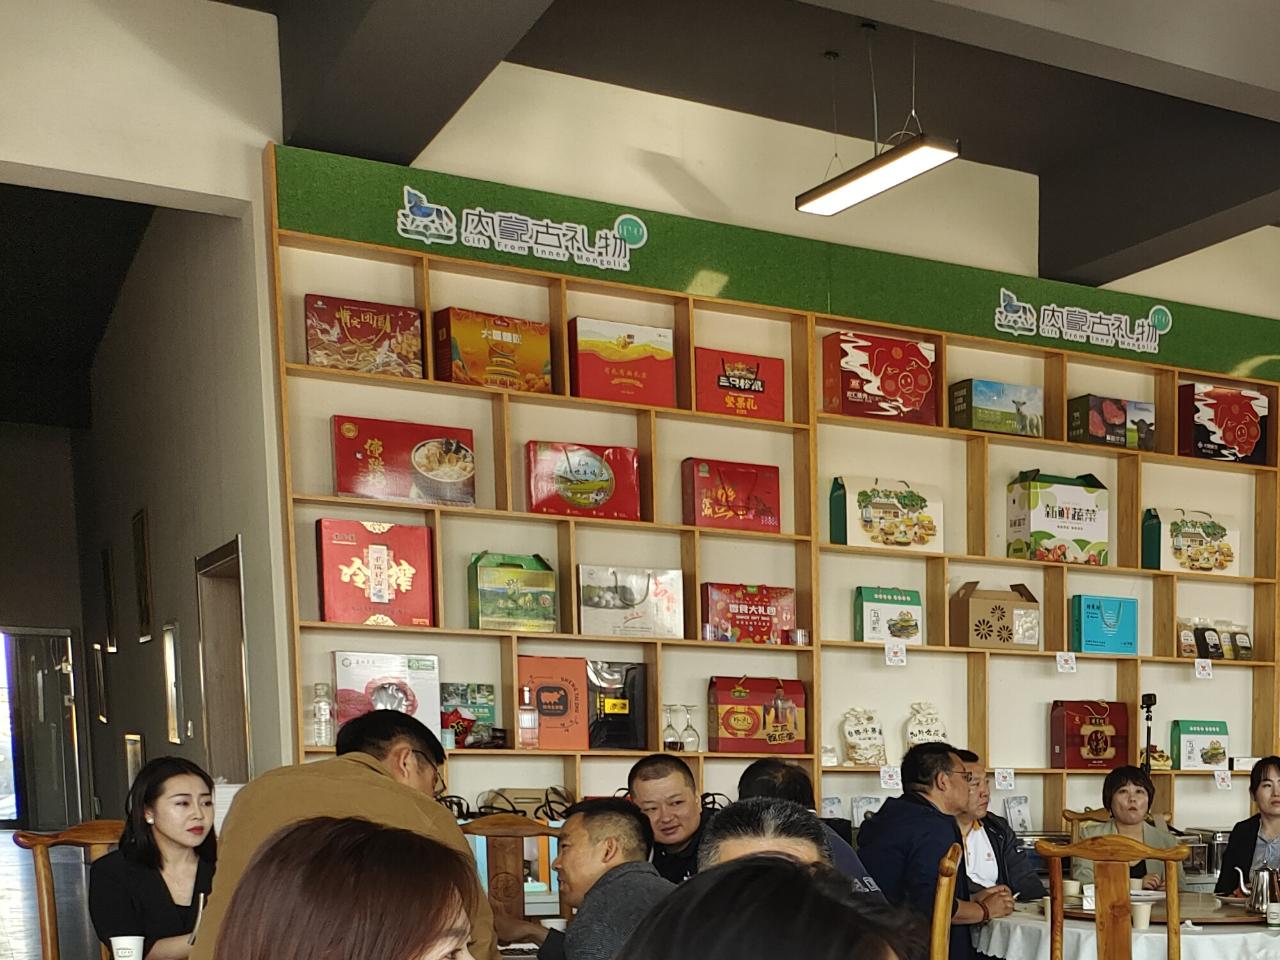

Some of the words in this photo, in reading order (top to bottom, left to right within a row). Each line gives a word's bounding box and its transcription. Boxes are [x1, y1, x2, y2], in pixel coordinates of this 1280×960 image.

[464, 210, 627, 259] 内蒙古礼物
[464, 235, 488, 246] Gift
[497, 241, 527, 252] From
[535, 247, 567, 259] Inner
[576, 254, 628, 269] Mongolia
[1041, 305, 1158, 343] 内蒙古礼物
[1041, 328, 1058, 337] Gift
[1063, 332, 1086, 341] From
